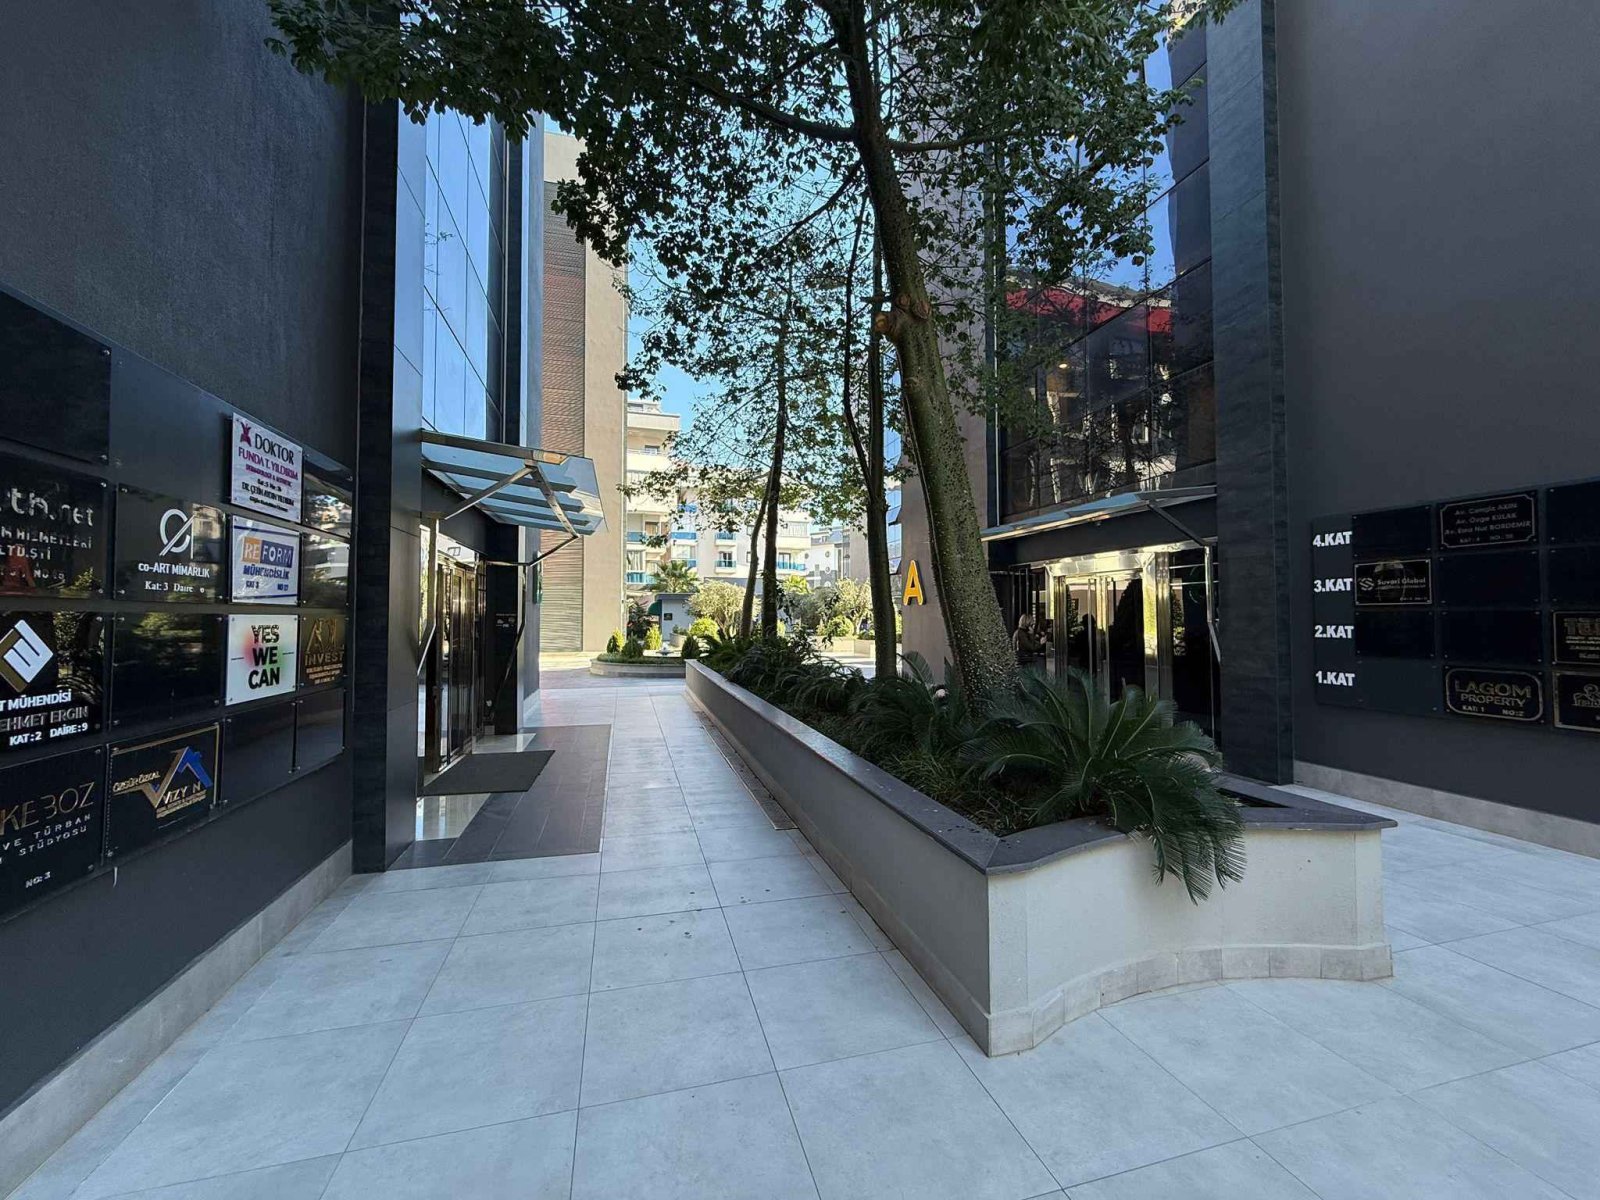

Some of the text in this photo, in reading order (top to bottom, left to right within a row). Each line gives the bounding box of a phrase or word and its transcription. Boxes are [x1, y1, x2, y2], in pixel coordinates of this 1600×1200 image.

[255, 433, 294, 465] DOKTOR
[239, 447, 264, 467] FUNDA
[271, 461, 298, 480] YILDIRIM
[1312, 531, 1352, 547] 4.KAT
[171, 563, 210, 578] MİMARLIK
[243, 564, 290, 580] MÜHENDİSLİK
[163, 582, 169, 591] 3
[903, 560, 925, 605] A
[1313, 578, 1353, 592] 3.KAT
[251, 624, 280, 644] YES
[1314, 625, 1354, 638] 2.KAT
[252, 646, 278, 666] WE
[305, 651, 345, 666] INVEST
[248, 667, 280, 690] CAN
[1316, 670, 1355, 686] 1.KAT
[1455, 680, 1531, 698] LAGOM
[8, 688, 72, 711] MÜHENDİSİ
[1461, 693, 1525, 707] PROPERTY
[33, 813, 91, 839] TÜRBAN
[19, 825, 87, 856] STÜDYOSU
